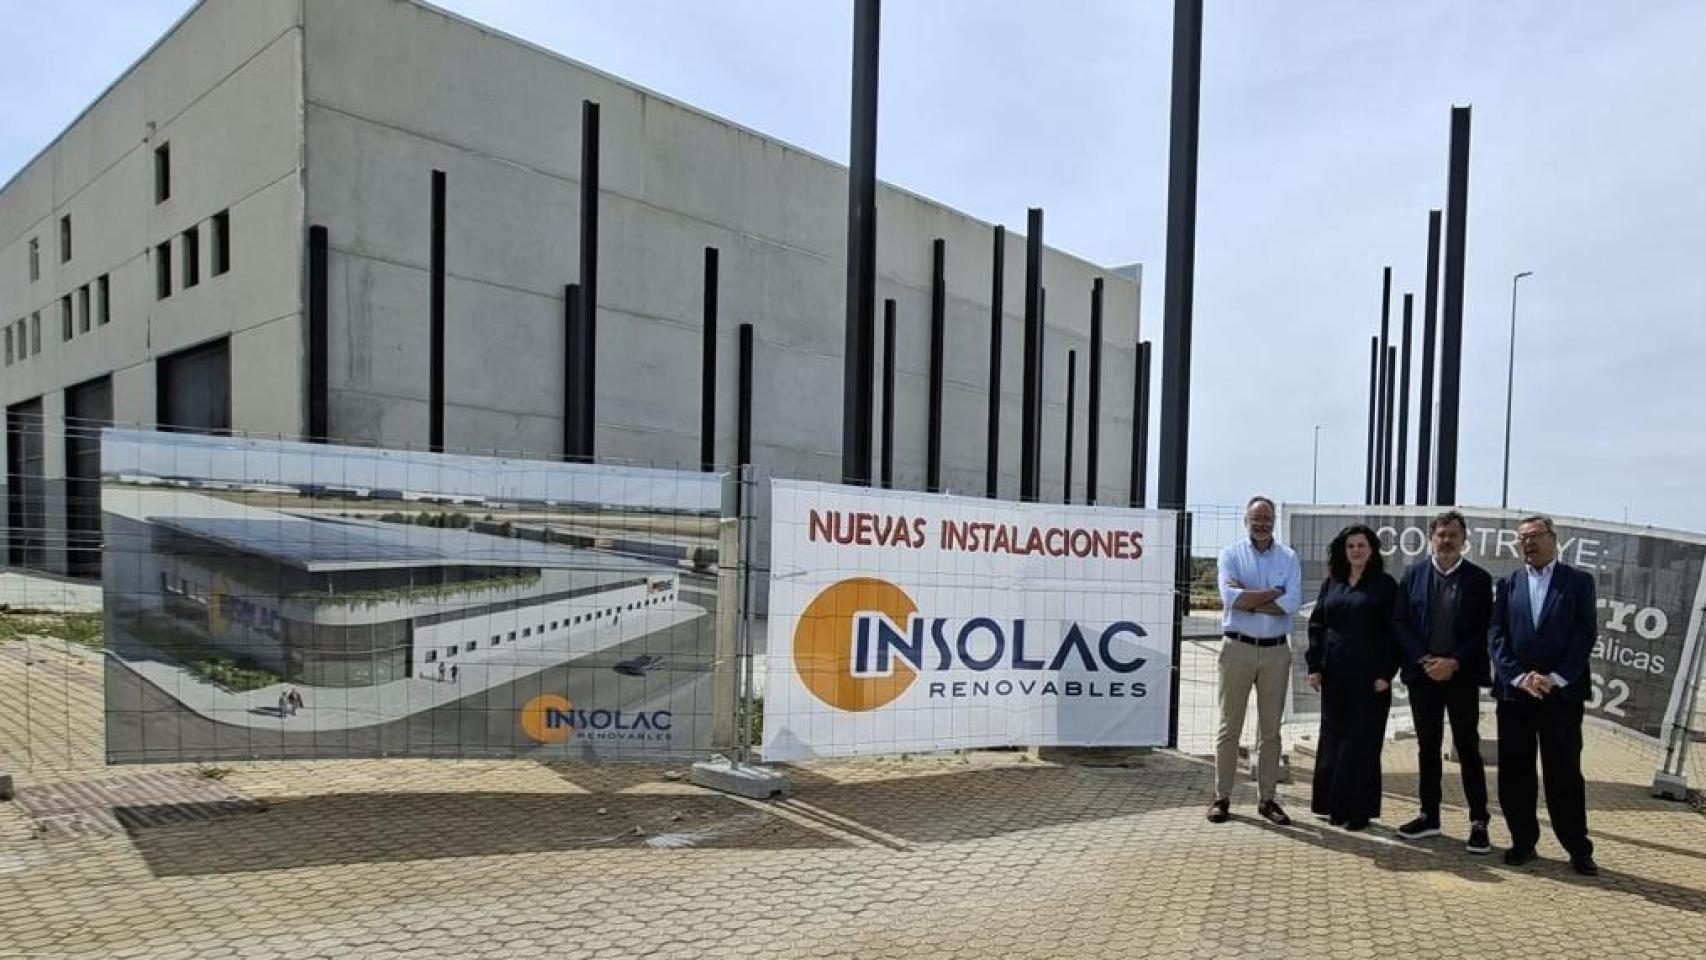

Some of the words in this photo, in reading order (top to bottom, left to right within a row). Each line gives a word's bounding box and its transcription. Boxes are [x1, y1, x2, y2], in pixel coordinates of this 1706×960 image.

[809, 509, 927, 548] NUEVAS
[941, 520, 1144, 560] INSTALACIONES
[1376, 525, 1609, 570] COSTRYE:
[1597, 598, 1668, 639] ro
[855, 616, 1149, 674] INSOLAC
[929, 679, 1148, 698] RENOVABLES
[545, 707, 672, 730] INSOLAC
[576, 731, 672, 741] RENOVABLES
